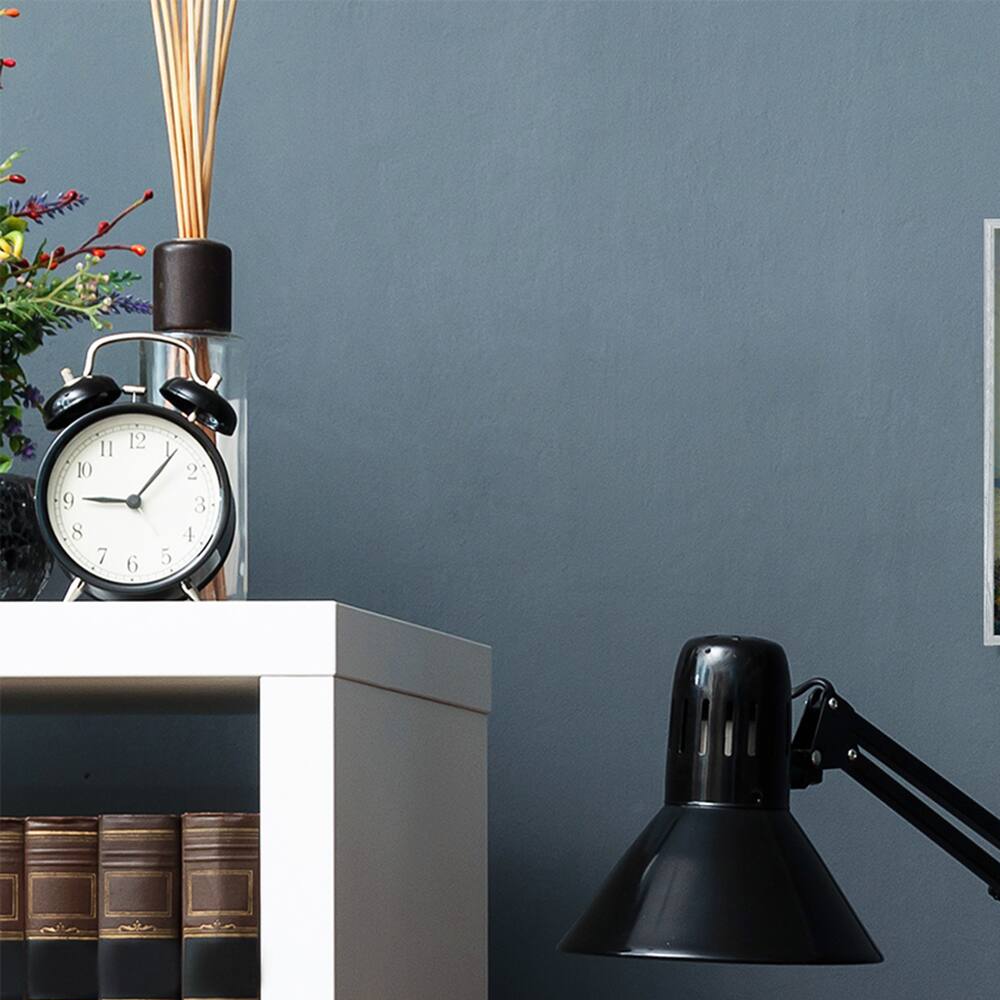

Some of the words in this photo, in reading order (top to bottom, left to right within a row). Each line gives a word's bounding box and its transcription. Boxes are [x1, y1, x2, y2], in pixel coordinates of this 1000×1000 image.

[100, 440, 113, 457] 11
[129, 432, 146, 449] 12
[165, 441, 170, 457] 1
[77, 462, 92, 478] 10
[187, 463, 197, 480] 2
[63, 492, 74, 509] 9
[194, 496, 206, 513] 3
[72, 523, 83, 539] 8
[183, 526, 195, 542] 4
[97, 548, 108, 565] 7
[127, 555, 138, 573] 6
[161, 548, 172, 565] 5
